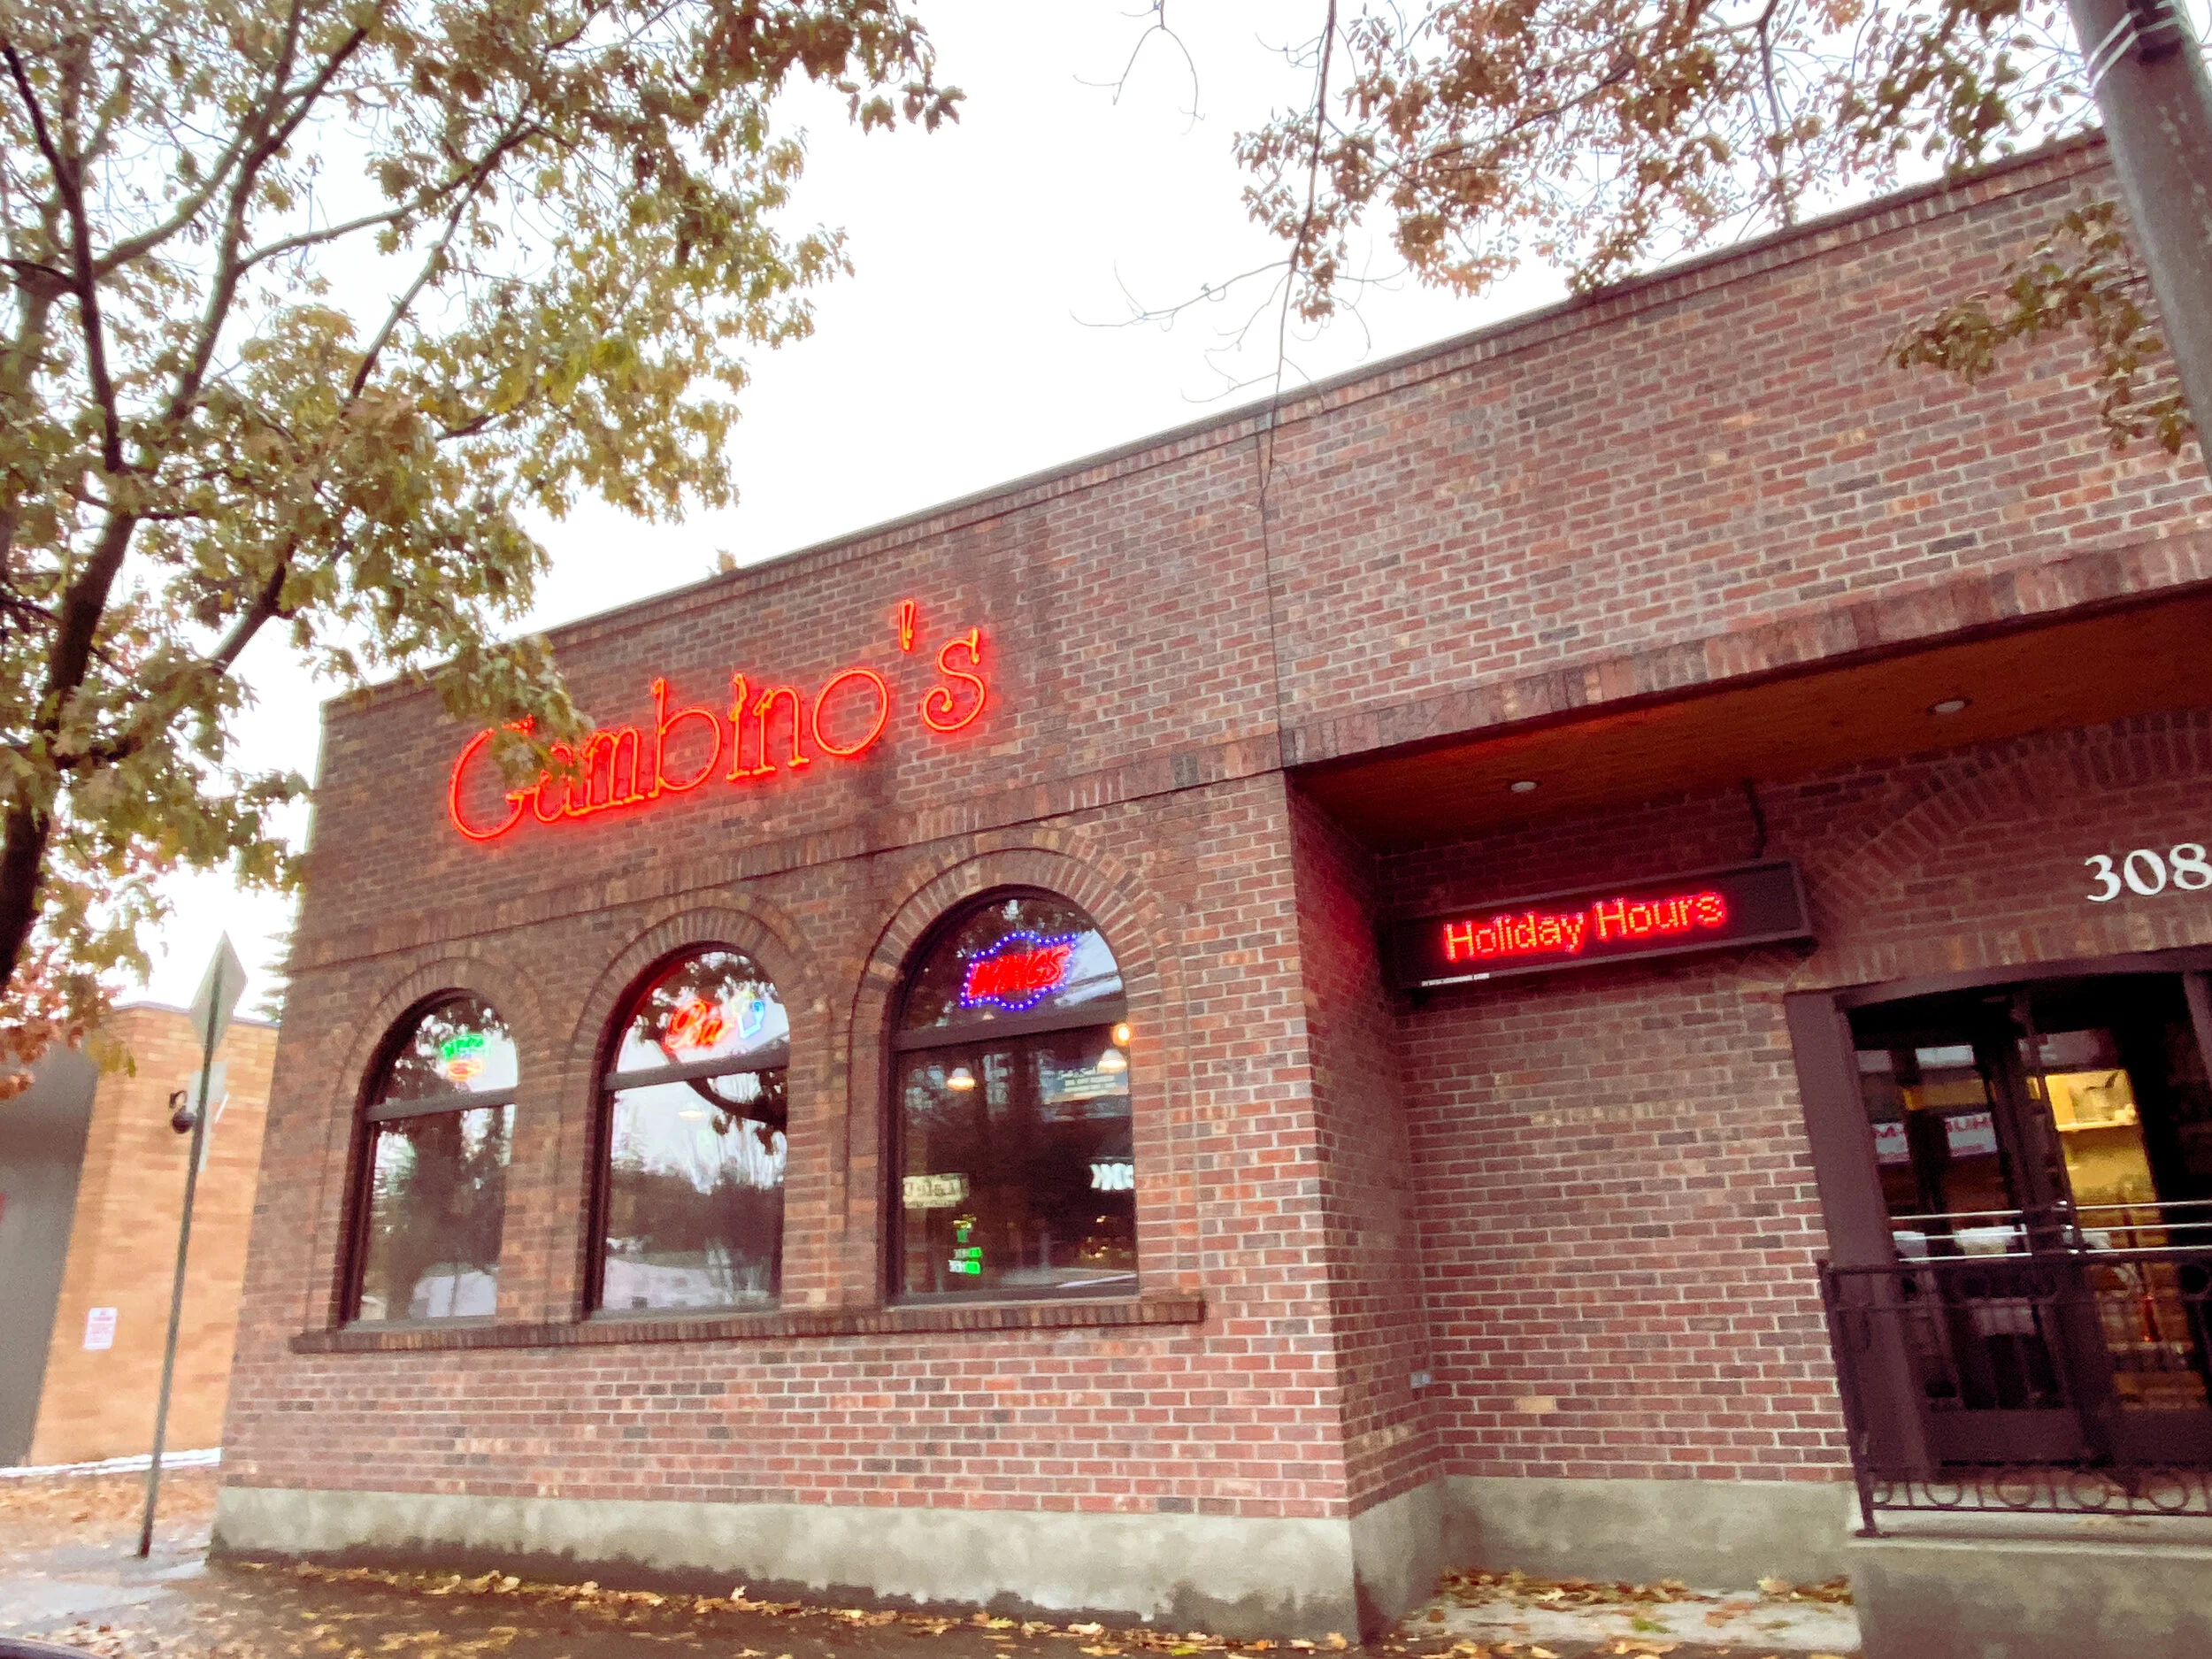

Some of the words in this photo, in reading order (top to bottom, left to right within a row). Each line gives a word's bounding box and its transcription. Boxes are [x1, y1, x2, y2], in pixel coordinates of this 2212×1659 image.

[449, 598, 987, 840] Gambino's
[2084, 842, 2212, 902] 308
[1444, 910, 1585, 962] Holiday
[1594, 891, 1726, 939] Hours
